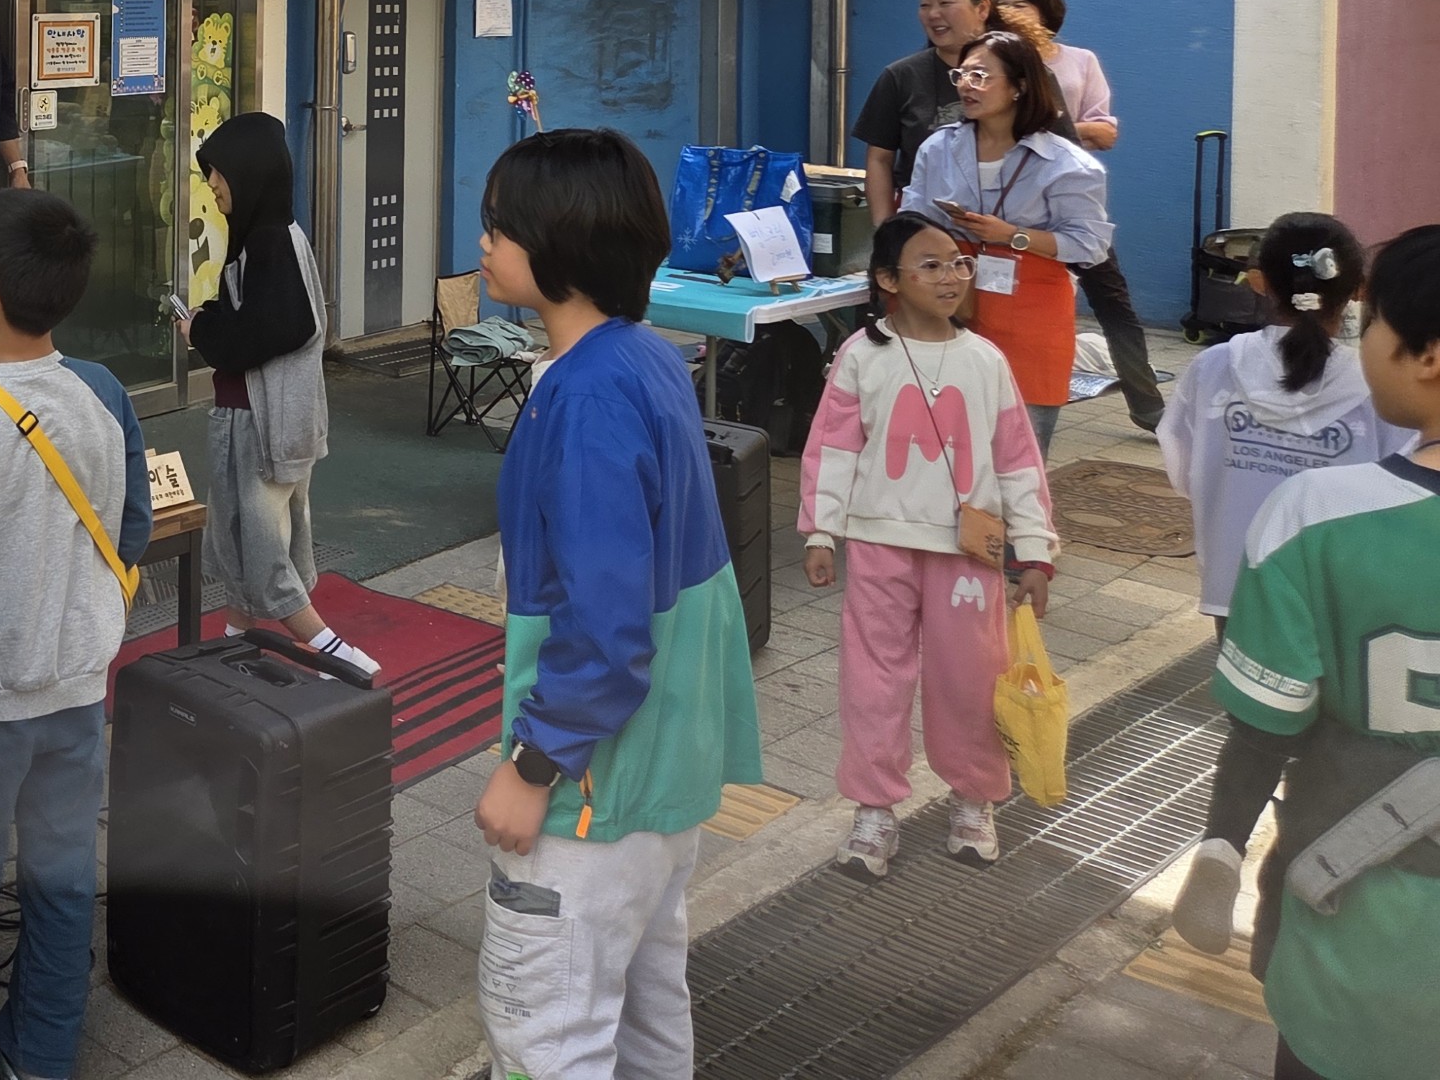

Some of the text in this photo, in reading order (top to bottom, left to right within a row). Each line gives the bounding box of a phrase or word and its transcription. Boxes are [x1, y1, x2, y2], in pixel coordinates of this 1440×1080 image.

[47, 28, 85, 39] 안내사항
[1232, 445, 1260, 458] LOS
[1224, 457, 1301, 478] CALIFORNI
